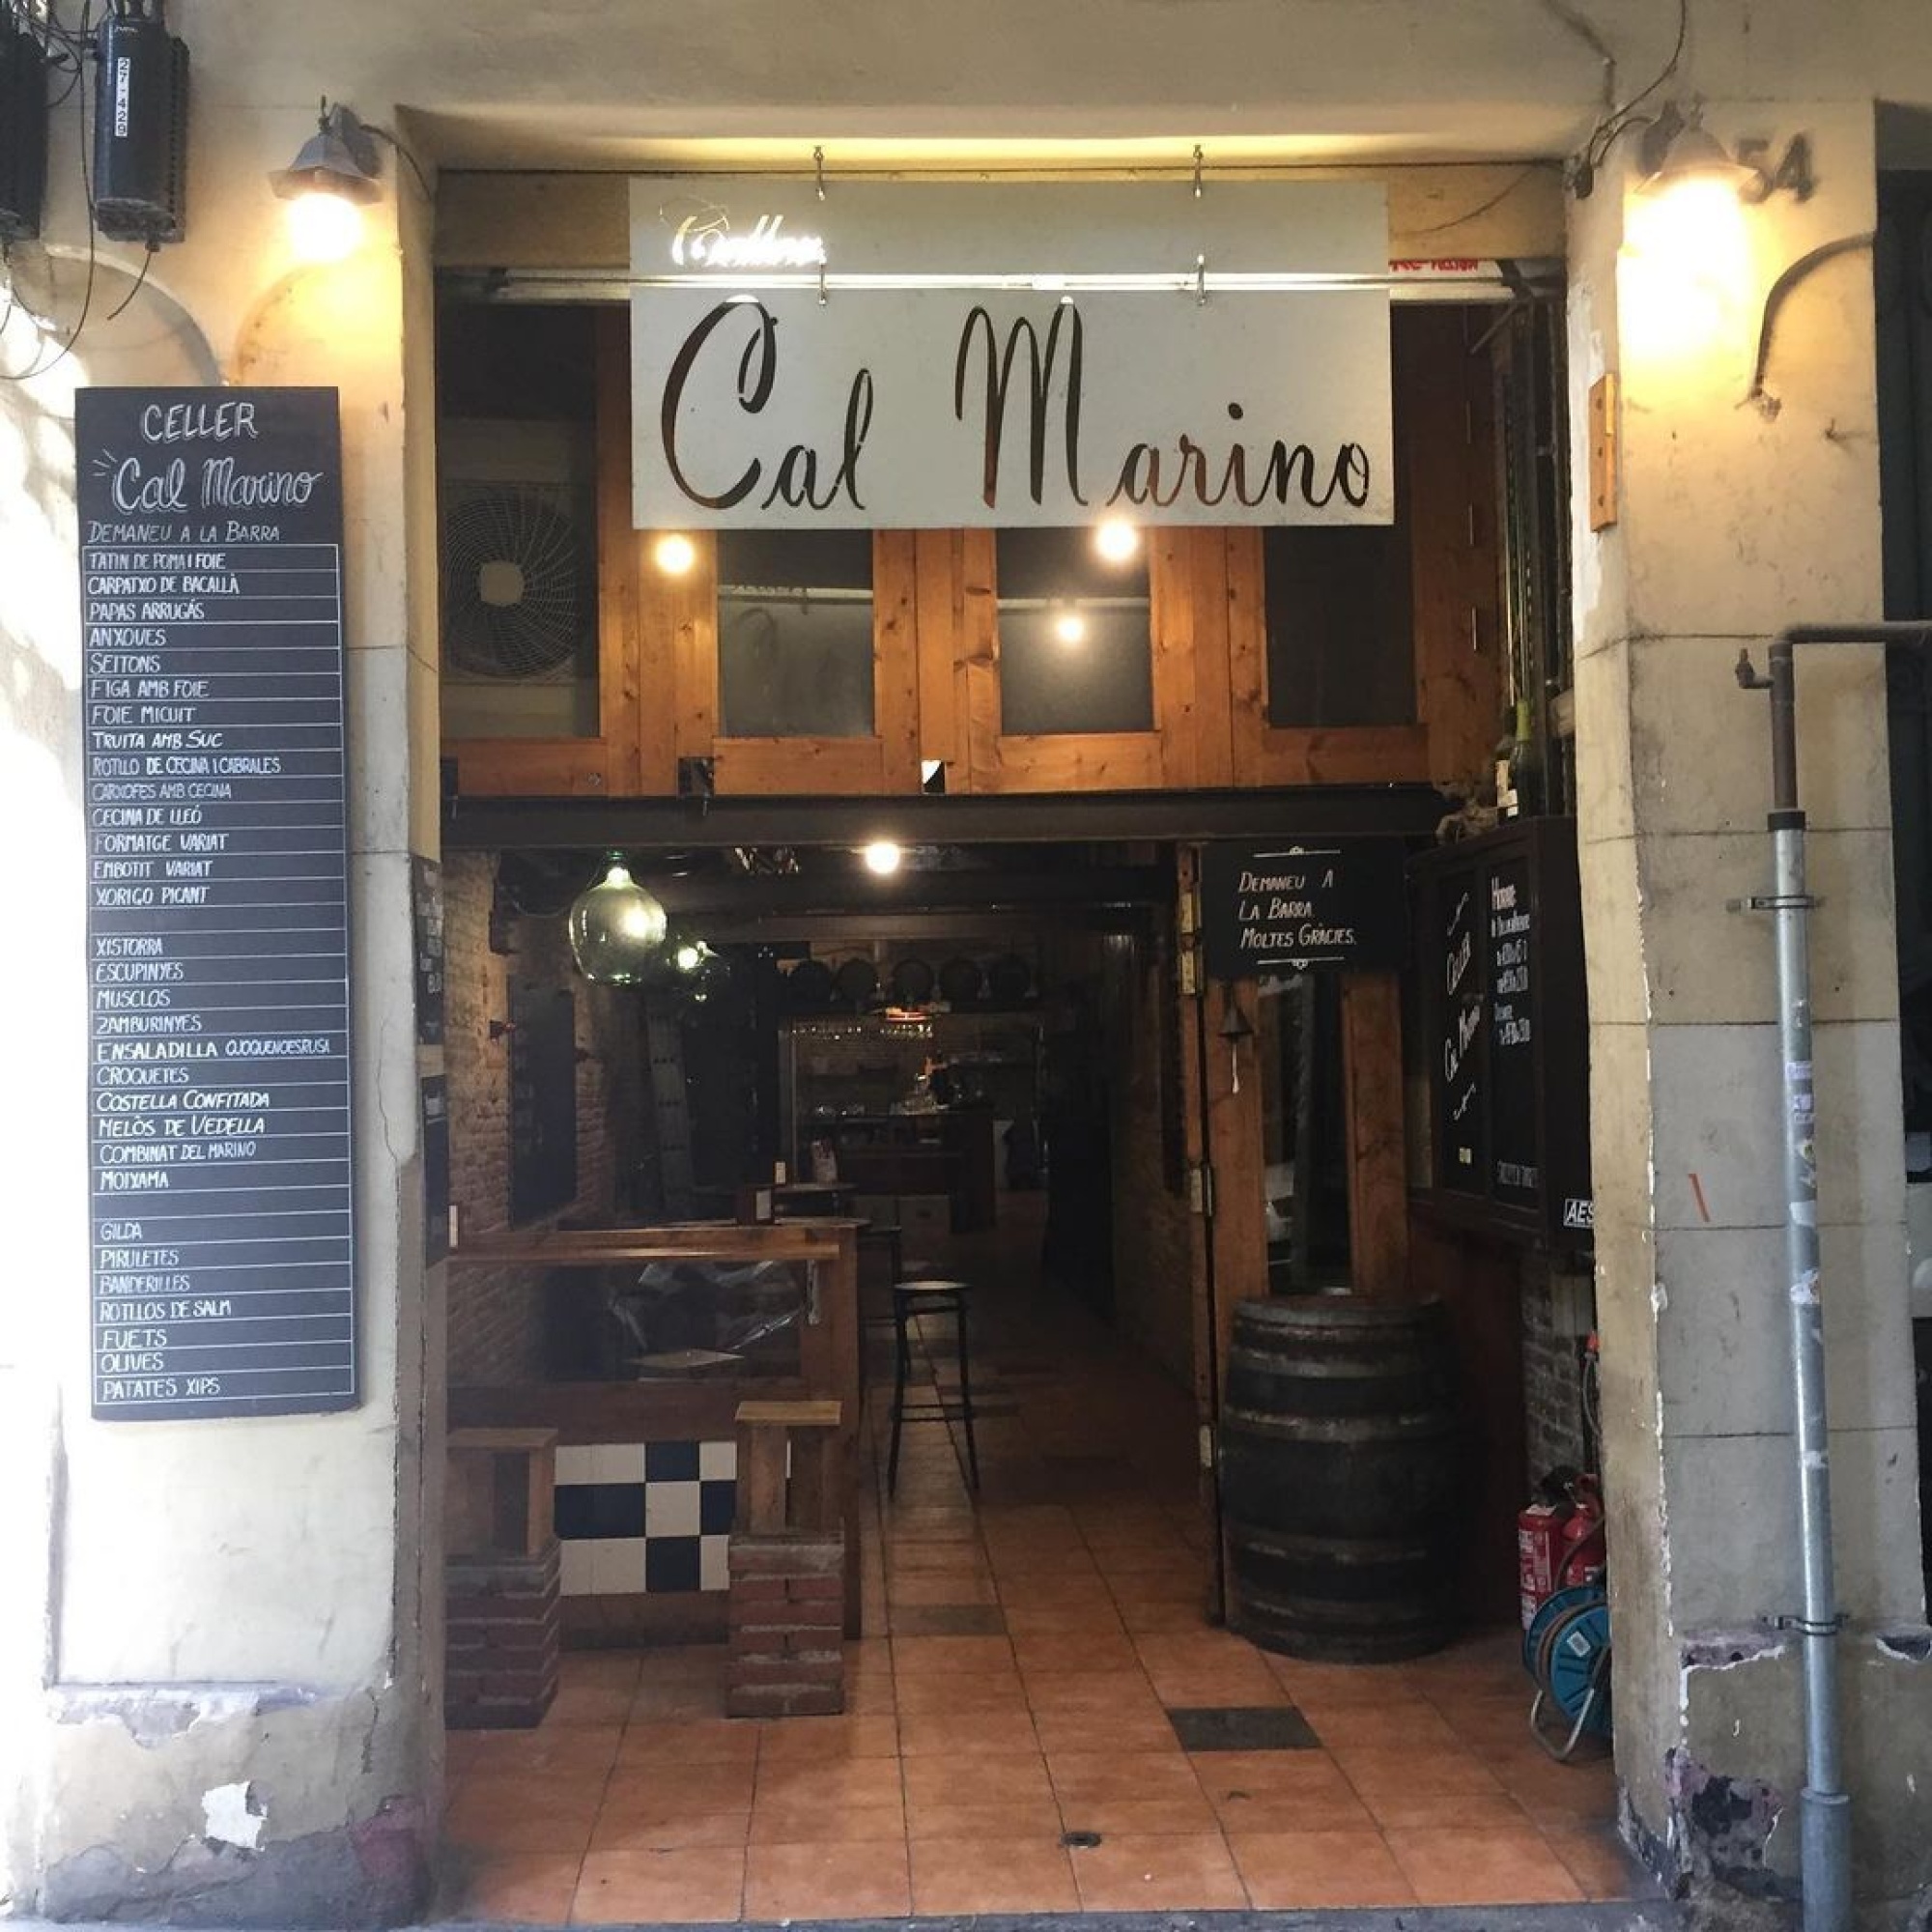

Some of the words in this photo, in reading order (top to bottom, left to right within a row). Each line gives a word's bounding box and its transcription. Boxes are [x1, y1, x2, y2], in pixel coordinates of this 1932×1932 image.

[662, 293, 873, 510] Cal
[954, 293, 1372, 510] Marino
[140, 402, 259, 443] CELLER
[112, 457, 188, 515] Cal
[201, 456, 324, 509] Marino
[87, 521, 172, 543] DEMANEU
[180, 526, 190, 542] A
[200, 525, 217, 543] LA
[225, 521, 280, 543] BARRA
[89, 553, 128, 570] TATIN
[134, 554, 151, 570] DE
[195, 553, 226, 570] FOIE
[87, 575, 156, 594] CARPATXO
[160, 576, 178, 593] DE
[90, 602, 136, 621] PAPAS
[89, 628, 166, 646] ANXOUES
[90, 653, 161, 674] SEITONS
[91, 680, 130, 698] FIGA
[137, 680, 169, 698] AMB
[174, 680, 210, 698] FOIE
[92, 705, 133, 724] FOIE
[140, 706, 197, 724] MICUIT
[92, 731, 145, 750] TRUITA
[152, 732, 183, 750] AMB
[185, 729, 223, 749] SUC
[146, 756, 164, 775] DE
[159, 783, 185, 800] AMB
[146, 808, 164, 826] DE
[96, 833, 172, 853] FORMATGE
[180, 833, 229, 851] VARIAT
[94, 860, 155, 879] EMBOTIT
[165, 860, 213, 877] VARIAT
[1237, 871, 1305, 893] DEMANEU
[1321, 869, 1334, 888] A
[1237, 899, 1260, 922] LA
[1267, 896, 1313, 919] BARRA
[96, 937, 163, 957] XISTORRA
[1239, 927, 1294, 950] MOLTES
[96, 962, 184, 982] ESCUPINYES
[96, 989, 171, 1009] MUSCLOS
[98, 1041, 218, 1062] ENSALADILLA
[97, 1065, 189, 1085] CROQUETES
[97, 1092, 178, 1112] COSTELLA
[183, 1090, 270, 1110] CONFITADA
[164, 1119, 186, 1137] DE
[191, 1115, 265, 1135] VEDELLA
[99, 1145, 179, 1164] COMBINAT
[181, 1144, 206, 1160] DEL
[208, 1141, 256, 1159] MARINO
[99, 1222, 142, 1240] GILDA
[99, 1275, 190, 1294] BANDERILLES
[170, 1301, 189, 1318] DE
[102, 1329, 167, 1350] FUETS
[101, 1352, 164, 1373] OLIVES
[102, 1378, 178, 1400] PATATES
[185, 1378, 221, 1397] XIPS
